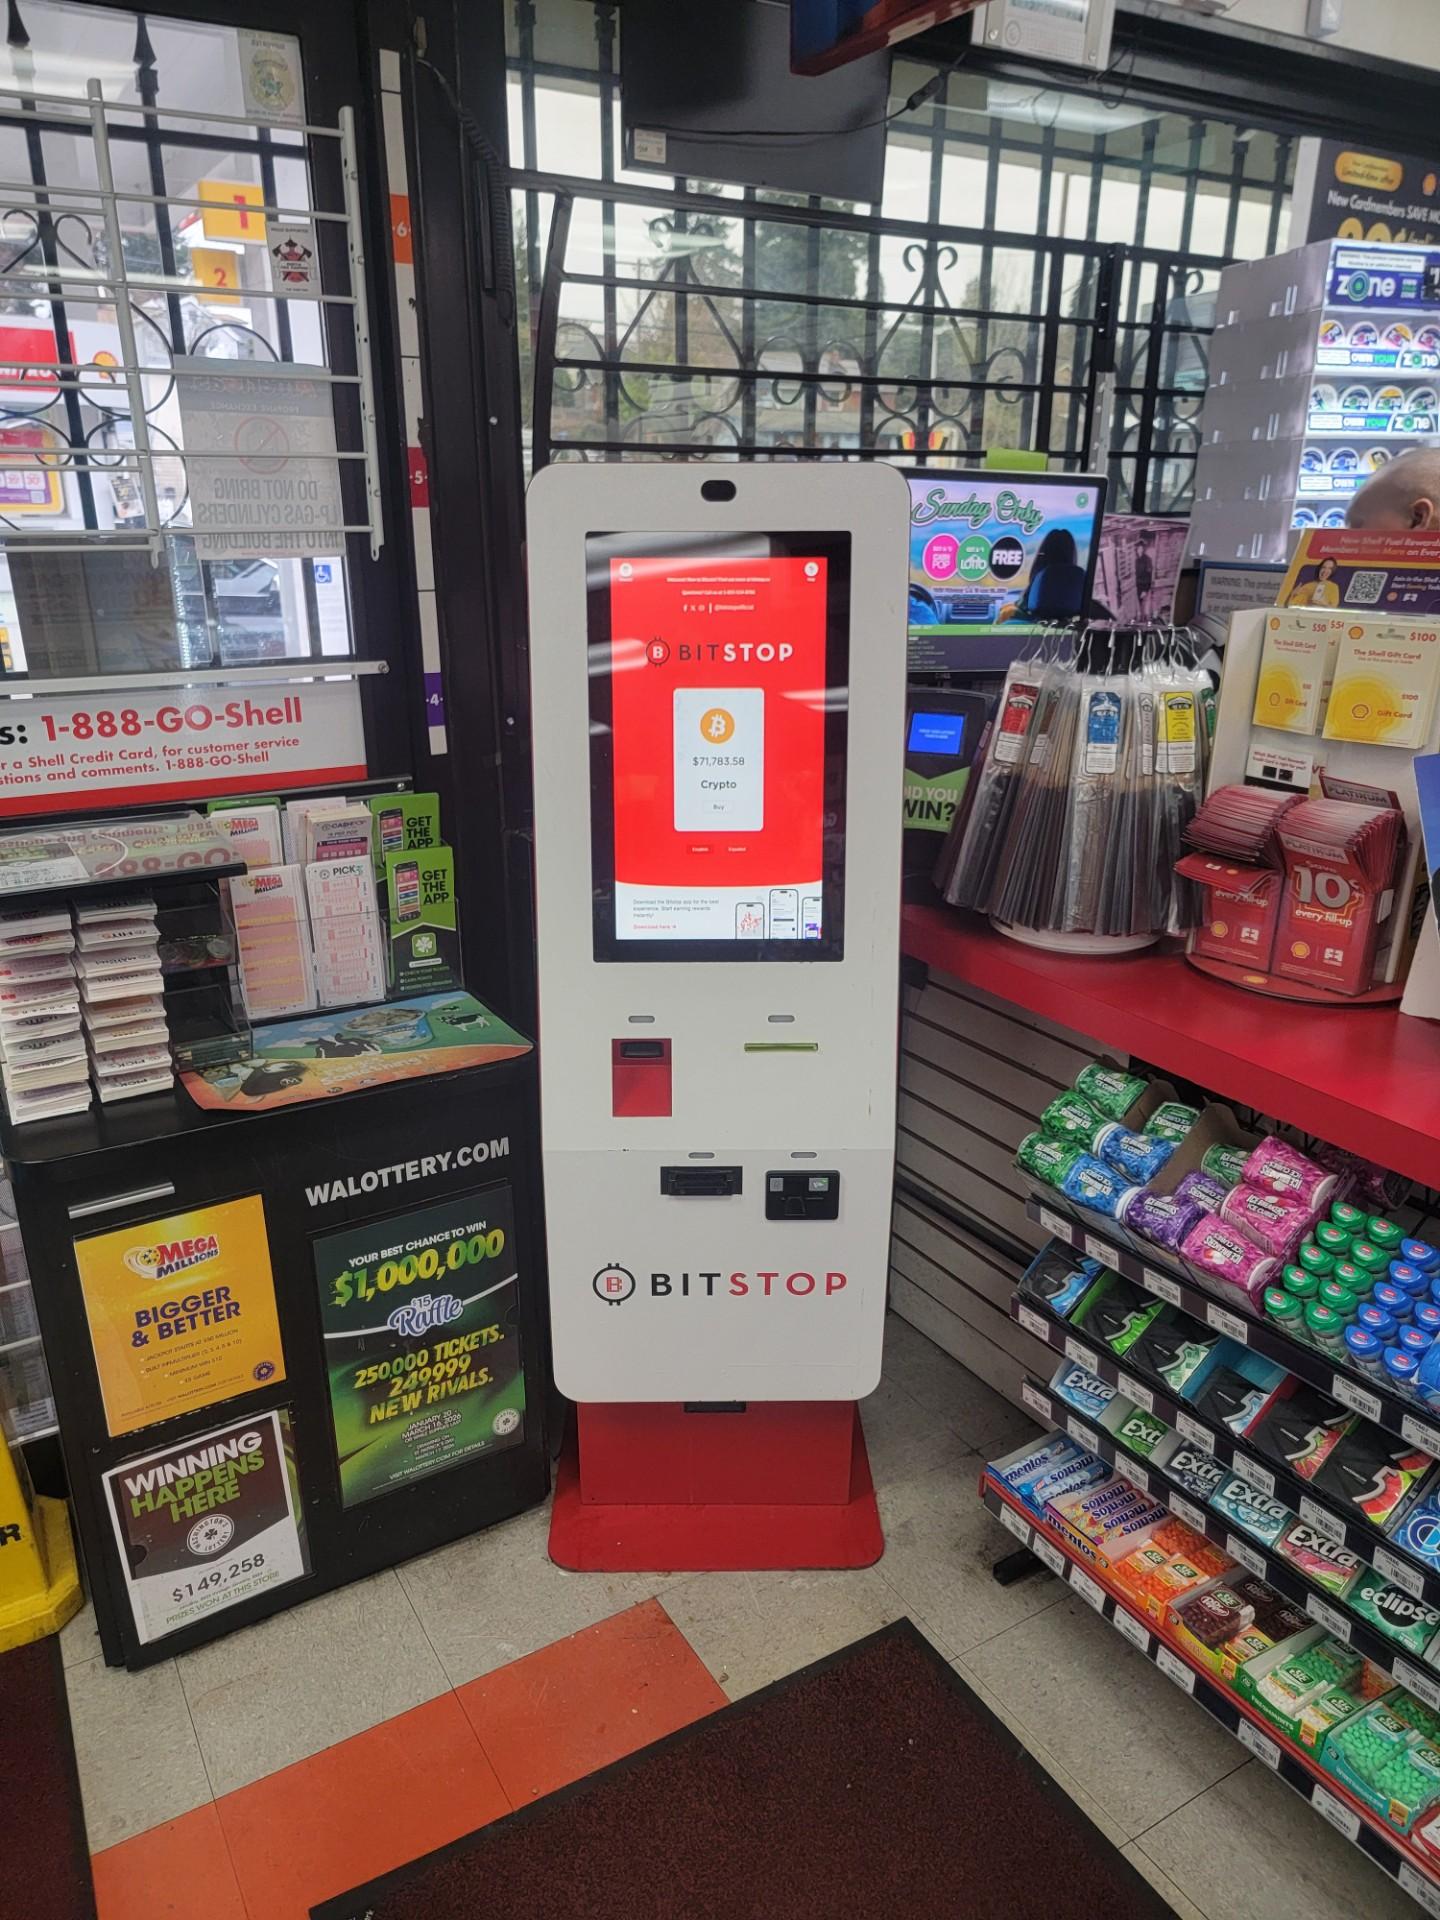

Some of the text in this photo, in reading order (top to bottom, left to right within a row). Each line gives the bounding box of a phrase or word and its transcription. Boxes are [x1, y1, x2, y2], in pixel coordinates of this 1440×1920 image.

[233, 195, 249, 230] 1
[1328, 190, 1349, 207] New
[396, 224, 408, 236] 6
[213, 267, 228, 288] 2
[413, 471, 424, 485] 5
[911, 489, 991, 529] Sunday
[992, 549, 1022, 565] FREE
[1312, 624, 1327, 632] $50
[1410, 632, 1437, 642] $100
[679, 643, 793, 662] BITSTOP
[1368, 650, 1386, 658] Shell
[1387, 651, 1401, 660] Gift
[1402, 653, 1422, 661] Card
[430, 693, 440, 706] 4
[41, 697, 303, 742] 1-888-GO-Shell
[1377, 710, 1412, 719] Gift Card
[12, 736, 300, 770] a Shell Credit Card, for customer service
[46, 768, 76, 782] and
[81, 762, 160, 780] comments.
[165, 751, 269, 772] 1-888-GO-Shell
[692, 757, 745, 768] $71,783.58
[700, 780, 737, 791] Crypto
[926, 787, 958, 801] YOU
[231, 818, 258, 830] MEGA
[406, 816, 432, 828] GET
[406, 827, 430, 838] THE
[408, 838, 433, 849] APP
[255, 876, 283, 888] MEGA
[333, 866, 355, 876] PICK
[422, 869, 447, 881] GET
[422, 881, 446, 892] THE
[424, 892, 449, 905] APP
[1295, 909, 1322, 923] every
[305, 1136, 510, 1207] WALOTTERY.COM
[156, 1235, 218, 1266] MEGA
[349, 1220, 487, 1268] YOUR BEST CHANCE TO WIN
[156, 1248, 219, 1280] MILLIONS
[330, 1227, 506, 1307] $1,000,000
[651, 1272, 847, 1297] BITSTOP
[135, 1285, 232, 1329] BIGGER
[388, 1295, 463, 1336] Raffle
[131, 1301, 242, 1348] & BETTER
[353, 1324, 505, 1389] 250,000 TICKETS.
[369, 1367, 493, 1424] NEW RIVALS.
[1064, 1371, 1116, 1400] Extra
[402, 1424, 431, 1440] MARCH
[408, 1414, 441, 1430] JANUARY
[124, 1431, 263, 1497] WINNING
[1005, 1454, 1050, 1482] mentos
[1050, 1454, 1095, 1483] mentos
[130, 1450, 266, 1518] HAPPENS
[169, 1480, 241, 1524] HERE
[1082, 1484, 1127, 1513] mentos
[1092, 1491, 1137, 1520] mentos
[1222, 1479, 1289, 1519] Extra
[1103, 1503, 1149, 1532] mentos
[1122, 1507, 1168, 1535] mentos
[1048, 1512, 1097, 1561] mentos
[1287, 1524, 1359, 1570] Extra
[172, 1553, 265, 1603] $149,258
[166, 1607, 195, 1625] PRIZES
[196, 1597, 221, 1614] WON
[252, 1570, 280, 1588] STORE
[1360, 1587, 1440, 1626] eclipse
